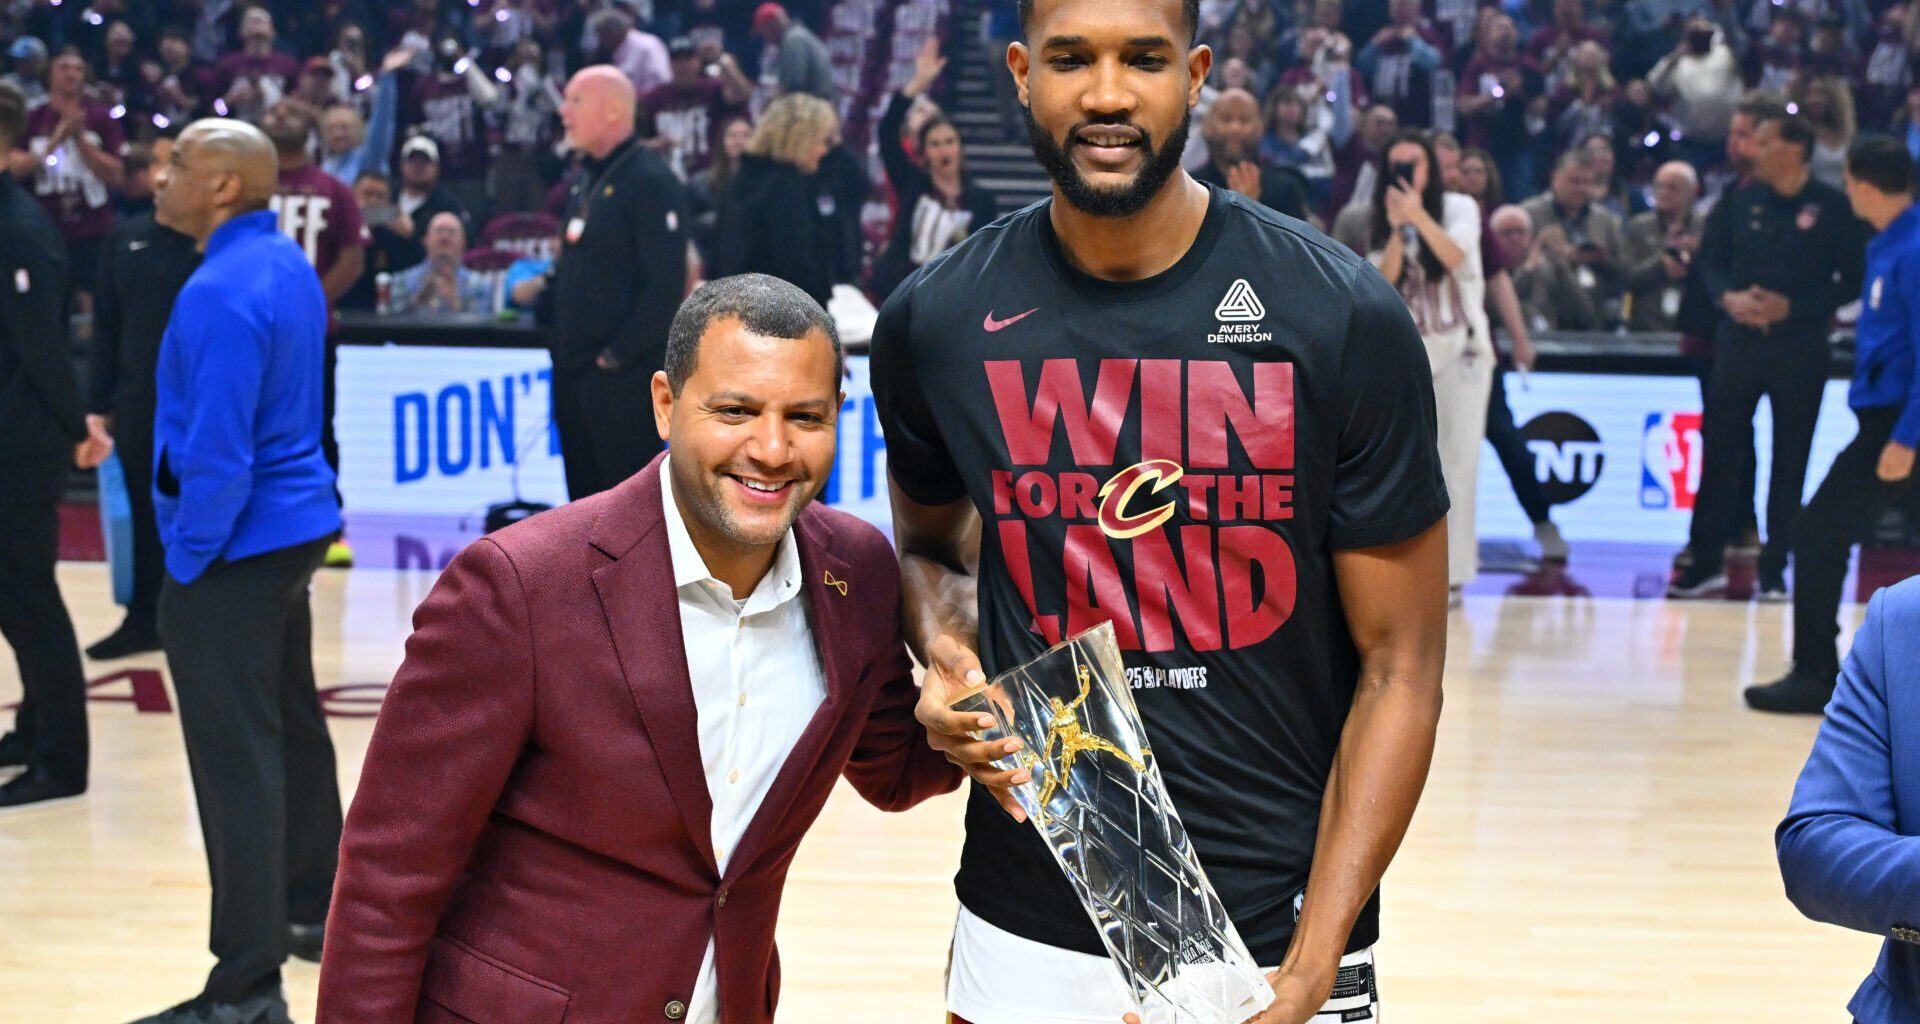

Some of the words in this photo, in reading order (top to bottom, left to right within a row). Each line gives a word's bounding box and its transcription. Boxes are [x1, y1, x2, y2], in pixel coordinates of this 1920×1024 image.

[1207, 333, 1272, 343] DENNISON
[1218, 324, 1260, 333] AVERY
[394, 368, 564, 485] DON'T
[984, 358, 1295, 470] WIN
[1526, 439, 1604, 484] TNT
[991, 469, 1100, 519] FOR
[1179, 474, 1295, 521] THE
[997, 519, 1297, 653] LAND
[1155, 666, 1207, 689] PLAYOFFS
